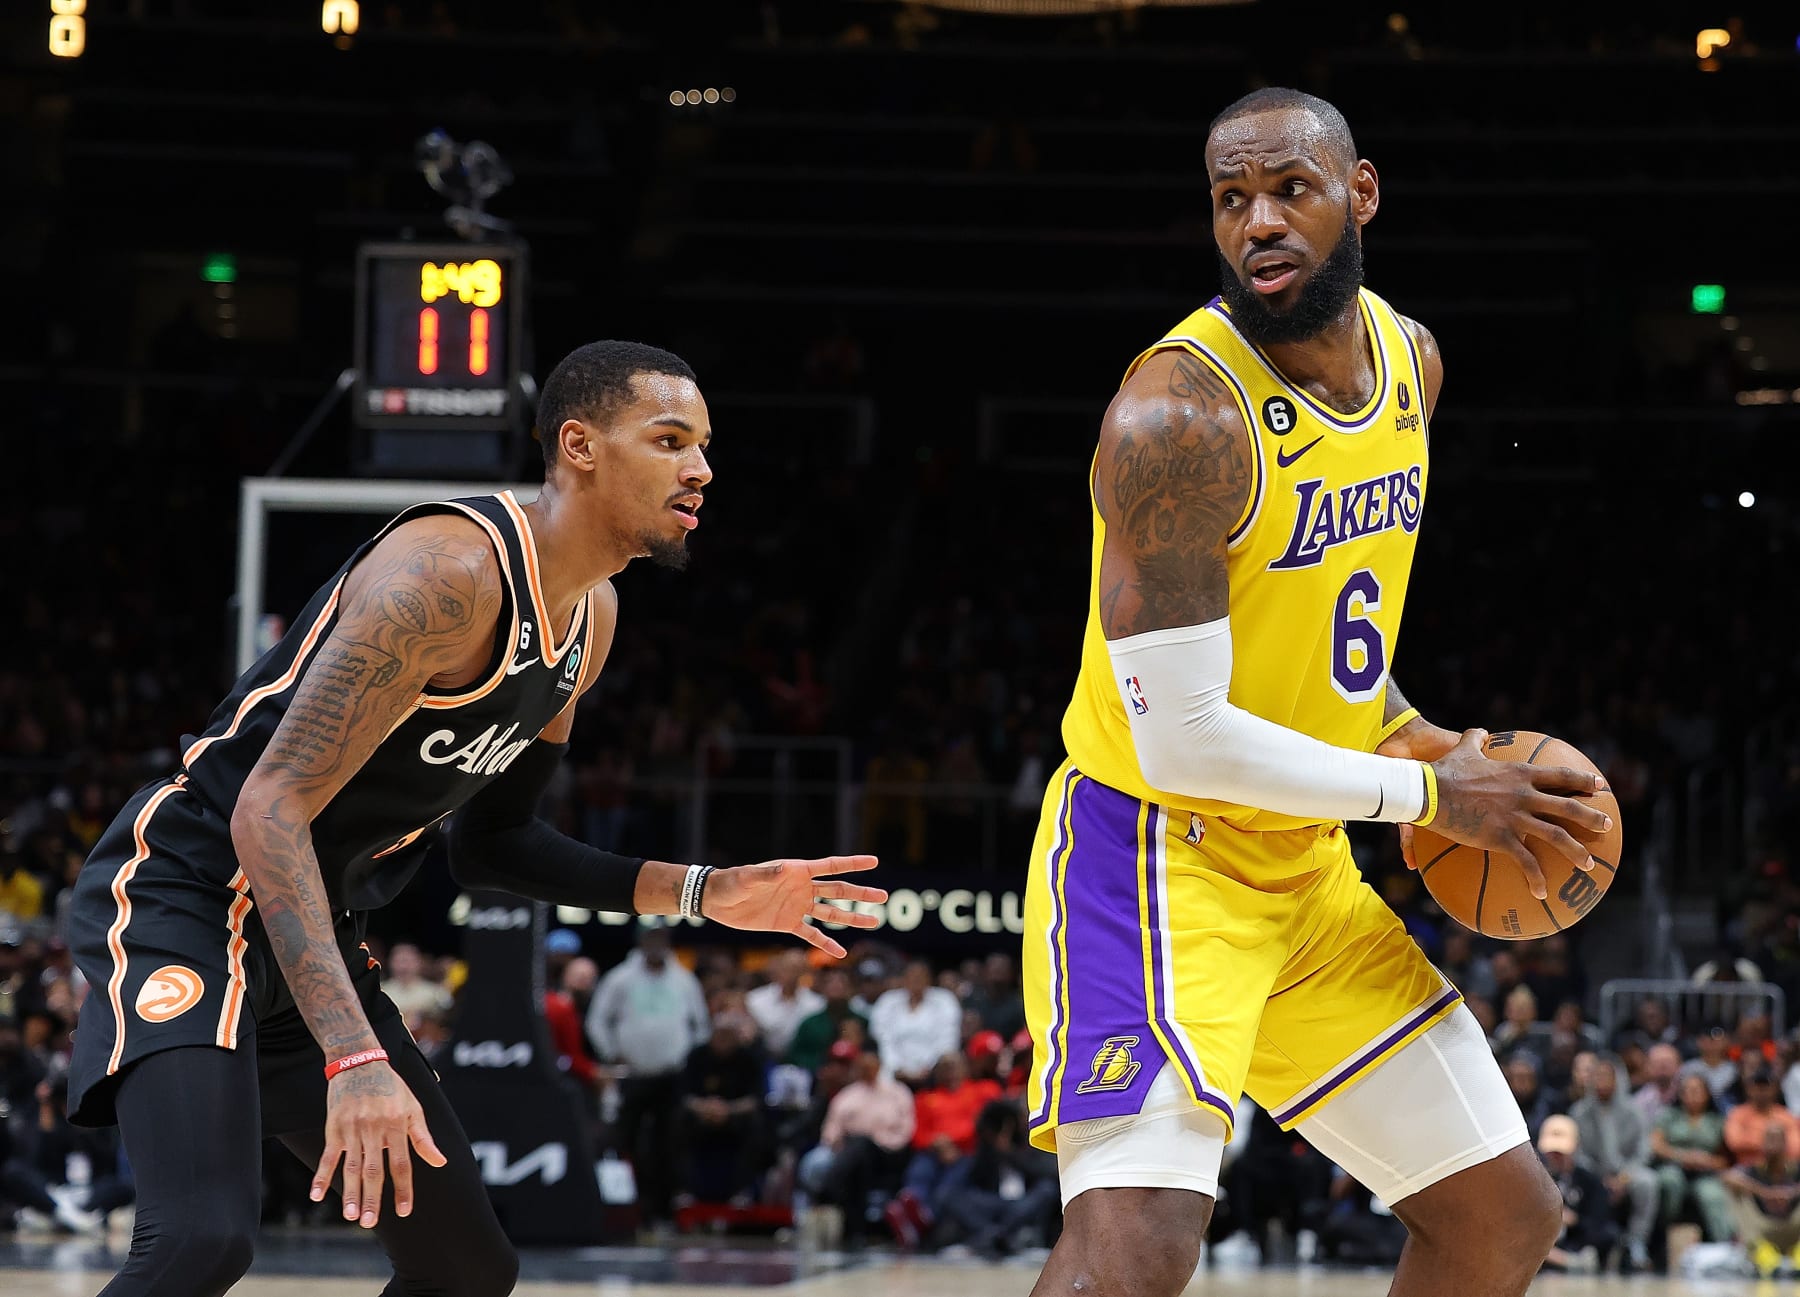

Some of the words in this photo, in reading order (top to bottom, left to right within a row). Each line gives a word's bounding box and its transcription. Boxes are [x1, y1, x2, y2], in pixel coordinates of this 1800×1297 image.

[418, 308, 489, 375] 11
[1268, 402, 1290, 431] 6
[1395, 412, 1419, 432] bibigo
[1265, 464, 1425, 572] LAKERS
[520, 621, 533, 650] 6
[1330, 567, 1389, 704] 6
[339, 1052, 377, 1070] MURRAY
